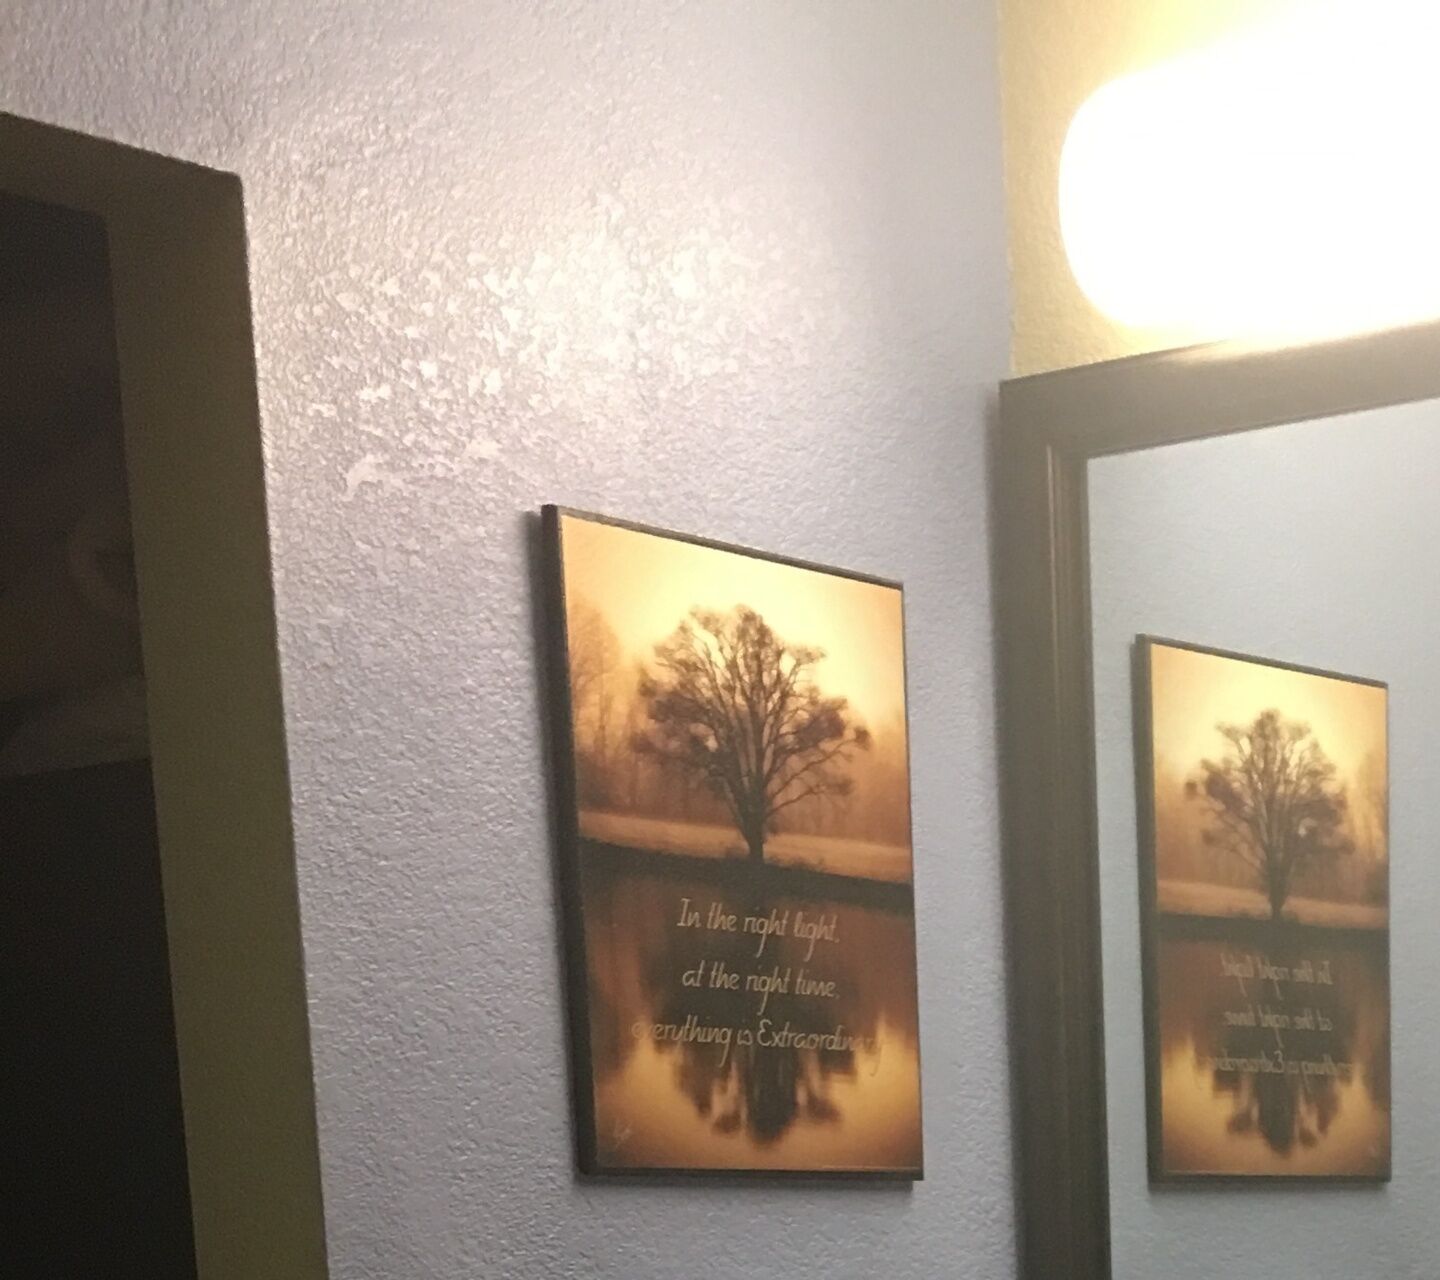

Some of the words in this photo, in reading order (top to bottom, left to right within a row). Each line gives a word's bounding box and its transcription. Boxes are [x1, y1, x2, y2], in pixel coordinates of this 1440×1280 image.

[677, 897, 702, 928] In
[707, 901, 737, 932] the
[743, 907, 789, 958] right
[681, 959, 706, 987] at
[709, 960, 740, 992] the
[745, 964, 792, 1016] right
[736, 1020, 754, 1046] is
